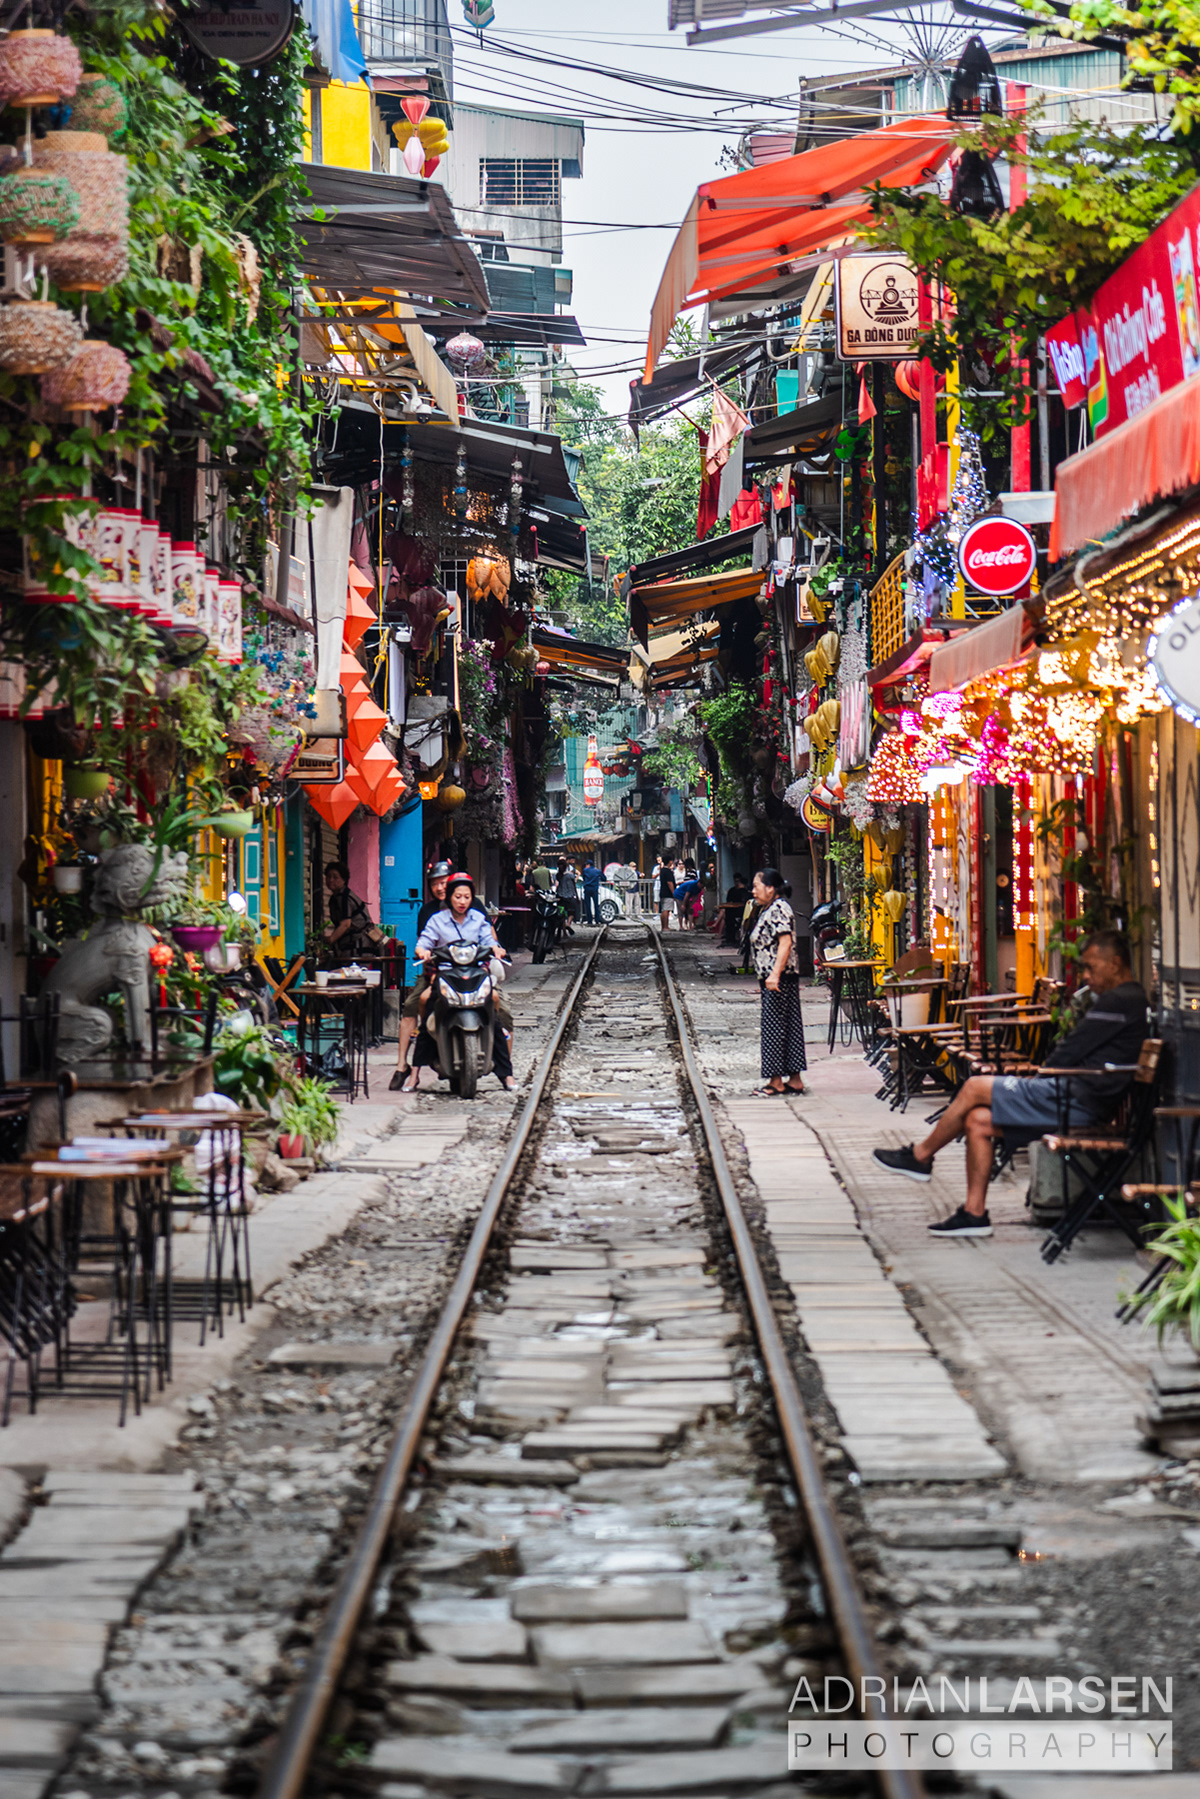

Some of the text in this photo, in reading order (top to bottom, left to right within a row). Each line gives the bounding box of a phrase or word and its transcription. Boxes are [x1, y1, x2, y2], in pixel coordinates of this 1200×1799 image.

[226, 13, 250, 25] TRAIN
[847, 330, 861, 342] GA
[864, 326, 893, 342] ĐÔNG
[1049, 339, 1086, 394] VinShop
[968, 544, 1026, 569] Coca-Cola
[1169, 607, 1200, 651] OL
